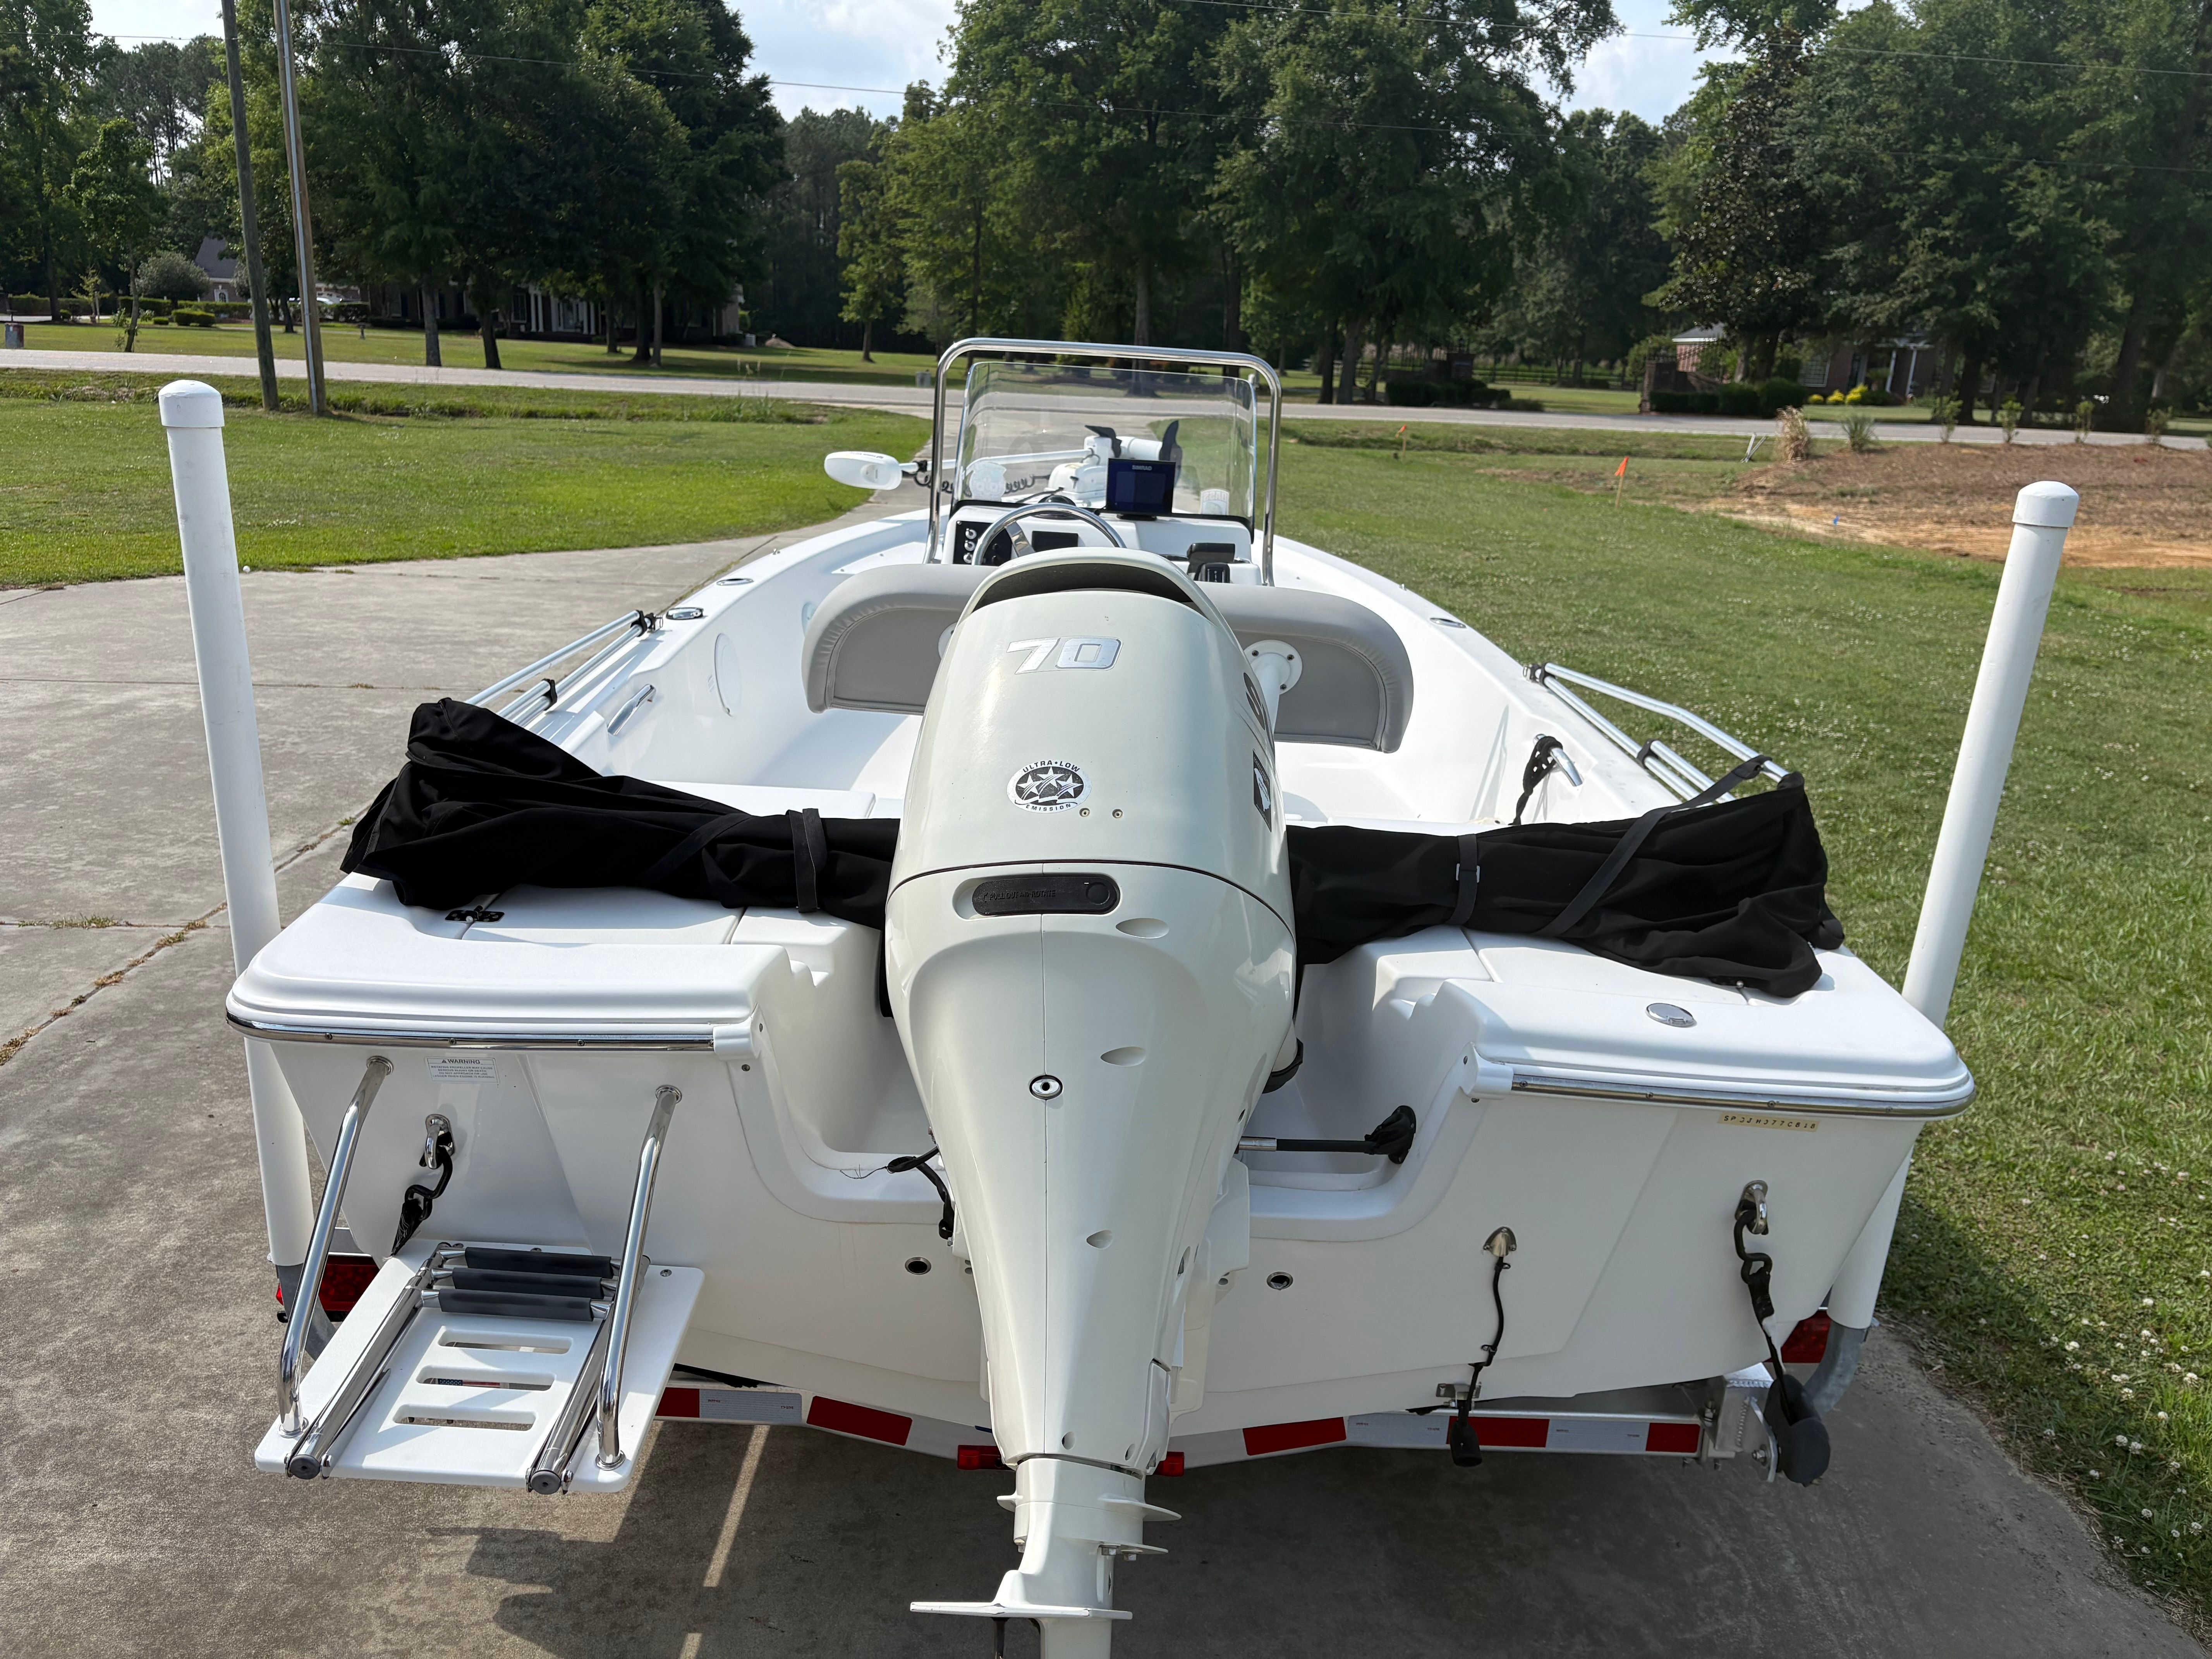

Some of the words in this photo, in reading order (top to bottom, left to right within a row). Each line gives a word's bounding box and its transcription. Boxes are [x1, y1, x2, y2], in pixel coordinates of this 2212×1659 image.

[1006, 635, 1123, 675] 70
[1022, 760, 1053, 773] ULTRA
[1059, 761, 1080, 772] LOW
[1025, 803, 1071, 811] EMISSION
[989, 892, 1005, 901] PULL
[1031, 890, 1056, 898] ROTATE
